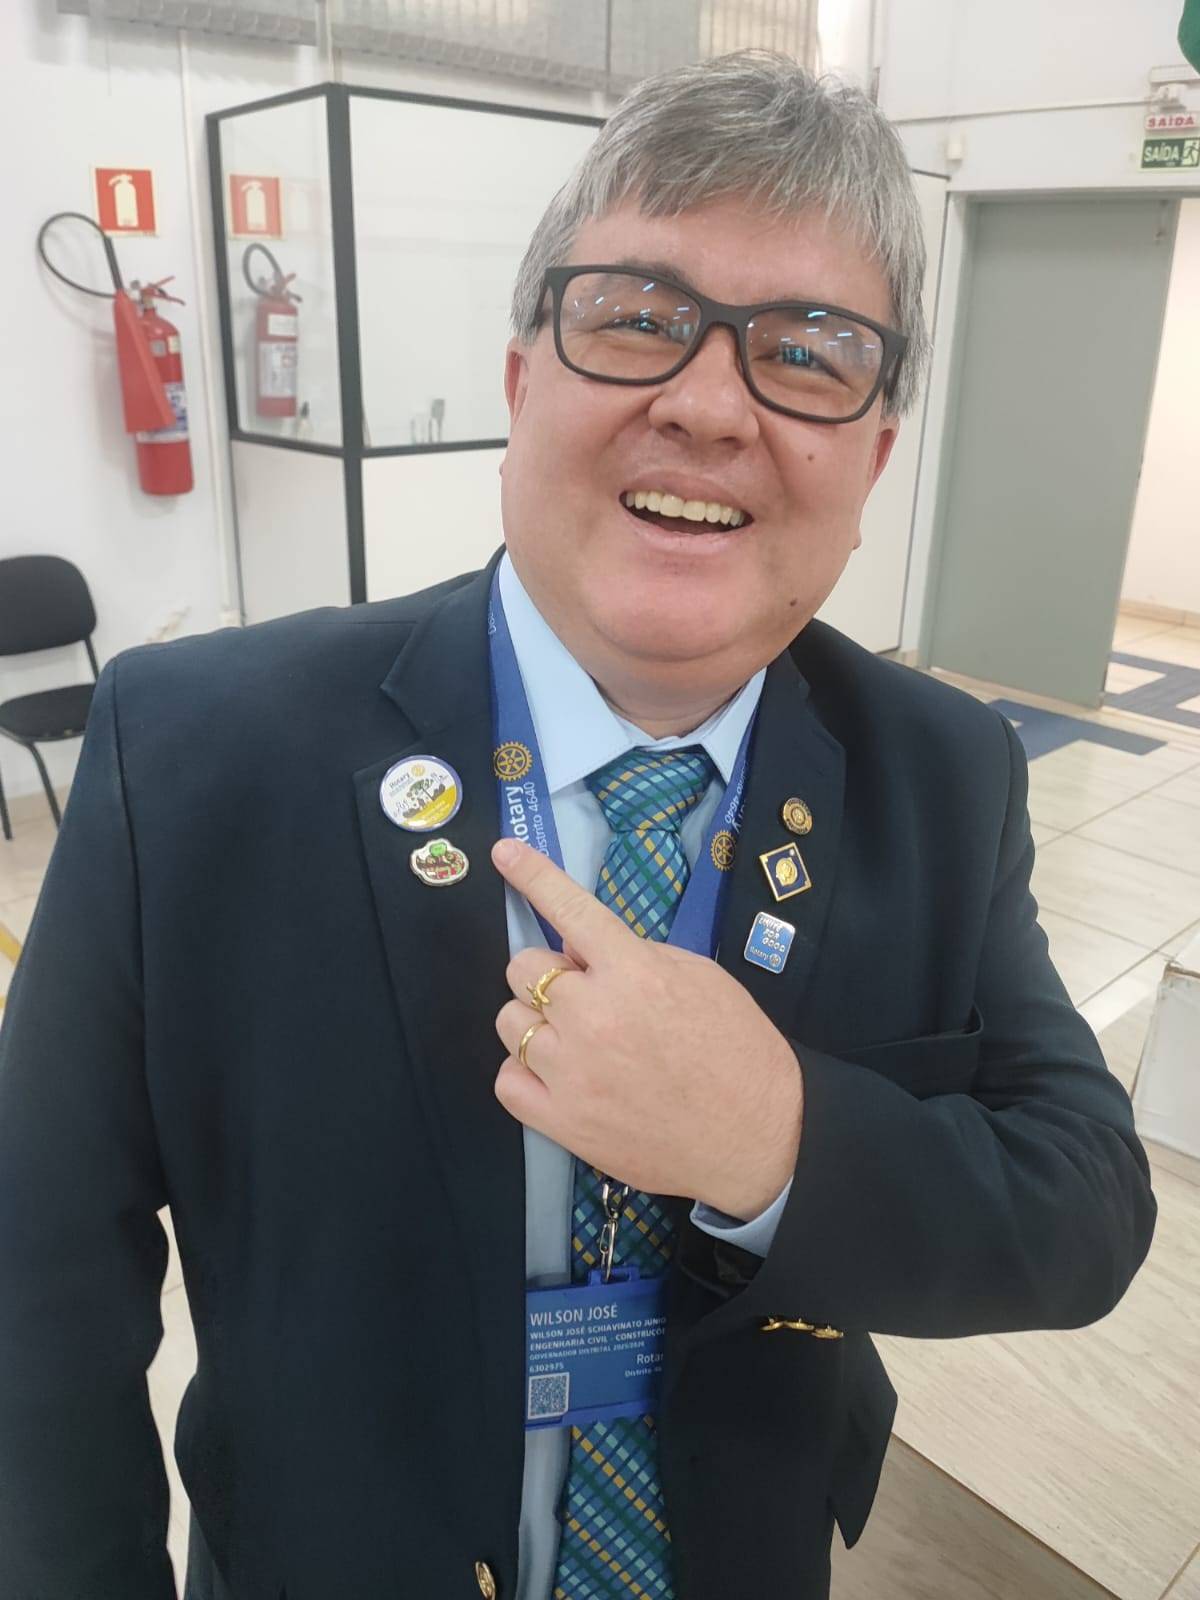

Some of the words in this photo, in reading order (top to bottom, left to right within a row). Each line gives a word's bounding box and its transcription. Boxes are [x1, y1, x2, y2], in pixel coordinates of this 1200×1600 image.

[1144, 142, 1180, 162] SAÍDA
[523, 781, 539, 812] 4640
[763, 928, 780, 941] FOR
[762, 937, 786, 953] GOOD
[530, 1308, 583, 1326] WILSON
[587, 1302, 618, 1321] JOSÉ
[530, 1329, 563, 1340] WILSON
[566, 1326, 585, 1336] JOSÉ
[588, 1320, 642, 1333] SCHIAVINATO
[530, 1338, 585, 1351] ENGENHARIA
[587, 1335, 608, 1345] CIVIL
